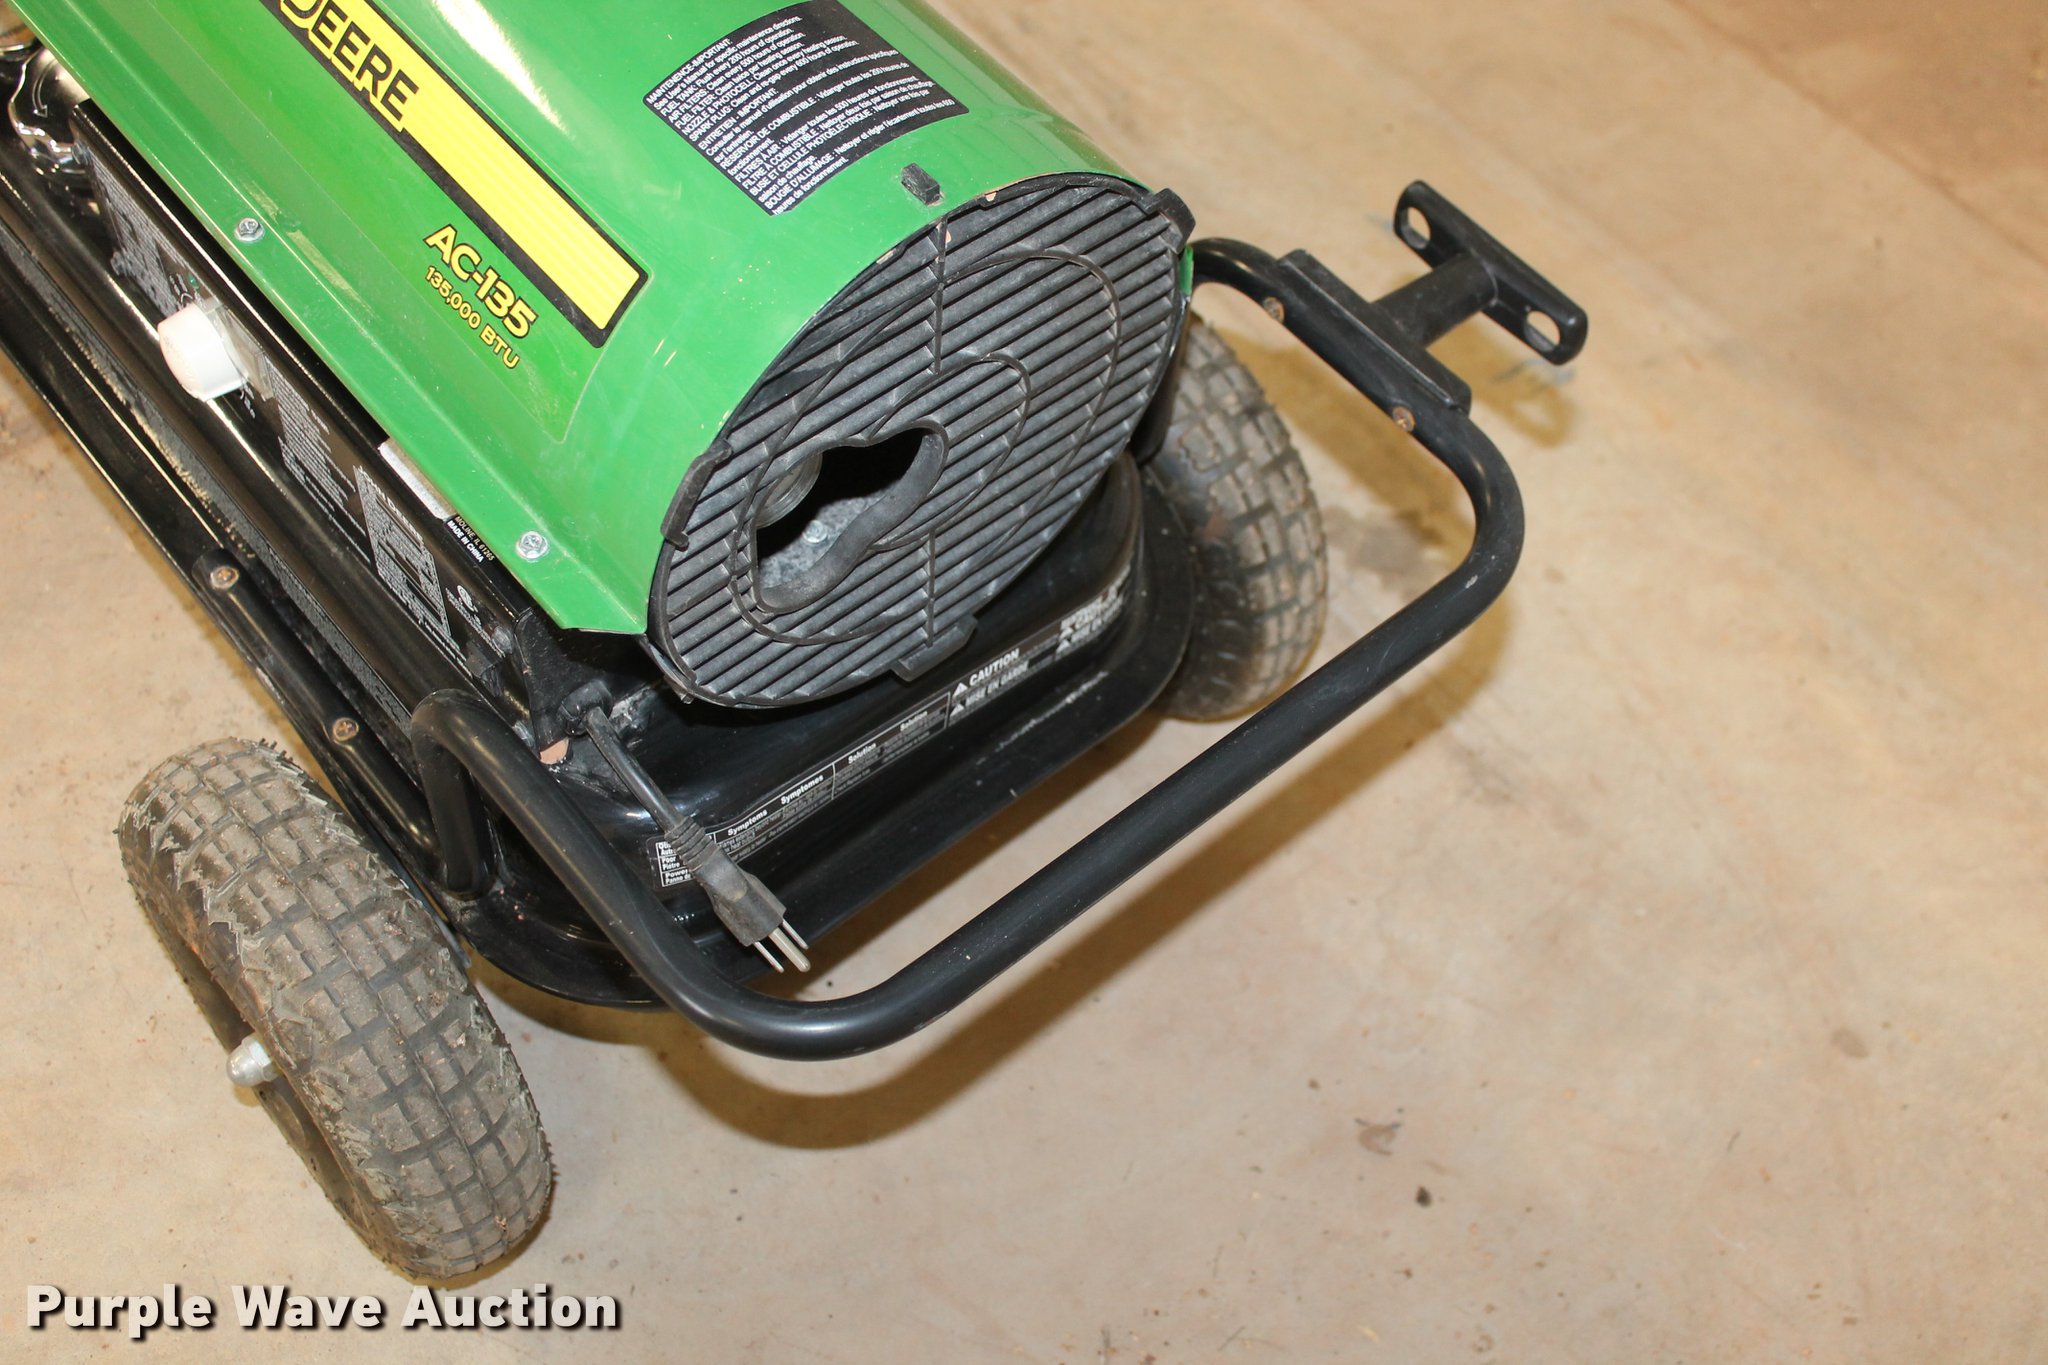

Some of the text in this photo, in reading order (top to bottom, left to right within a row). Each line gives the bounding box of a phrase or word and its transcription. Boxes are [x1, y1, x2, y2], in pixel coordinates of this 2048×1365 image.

[653, 16, 803, 110] See User's Manual for specific maintenance directions.
[660, 100, 681, 117] FUEL
[676, 84, 698, 101] TANK:
[695, 72, 714, 87] Flush
[712, 61, 731, 76] every
[728, 53, 742, 64] 200
[740, 44, 760, 57] hours
[765, 28, 795, 43] operation.
[668, 109, 683, 123] AIR
[679, 88, 709, 113] FILTERS:
[706, 76, 726, 91] Clean
[725, 65, 743, 78] every
[751, 48, 772, 60] hours
[776, 32, 806, 47] operation.
[674, 42, 805, 129] FUEL FILTER: Clean twice per heating season.
[681, 110, 710, 136] NOZZLE
[707, 106, 716, 115] &
[753, 67, 773, 80] Clean
[772, 59, 788, 71] once
[786, 51, 804, 63] every
[801, 42, 827, 54] heating
[689, 120, 714, 142] SPARK
[710, 105, 733, 124] PLUG:
[730, 92, 750, 108] Clean
[749, 83, 763, 96] and
[780, 64, 798, 76] every
[806, 50, 826, 62] hours
[698, 116, 737, 150] ENTRETIEN
[737, 87, 779, 117] IMPORTANT:
[740, 108, 763, 129] manuel
[792, 81, 807, 94] pour
[806, 71, 828, 85] obtenir
[826, 66, 840, 75] des
[757, 127, 771, 139] DE
[767, 97, 817, 130] COMBUSTIBLE
[713, 151, 726, 164] sur
[734, 157, 764, 183] FILTRES
[767, 143, 781, 157] AIR
[742, 166, 768, 190] FILTRE
[770, 128, 819, 166] COMBUSTIBLE
[749, 176, 771, 196] BUSE
[767, 169, 779, 180] ET
[777, 146, 810, 172] CELLULE
[764, 184, 793, 210] BOUGIE
[789, 152, 834, 187] D'ALLUMAGE
[758, 184, 780, 203] saison
[423, 223, 539, 338] AC-135
[425, 266, 519, 369] 135,000 BTU
[446, 520, 485, 563] MADE IN CHINA
[969, 648, 1020, 686] CAUTION
[848, 742, 876, 764] Solution
[727, 809, 768, 836] Symptoms
